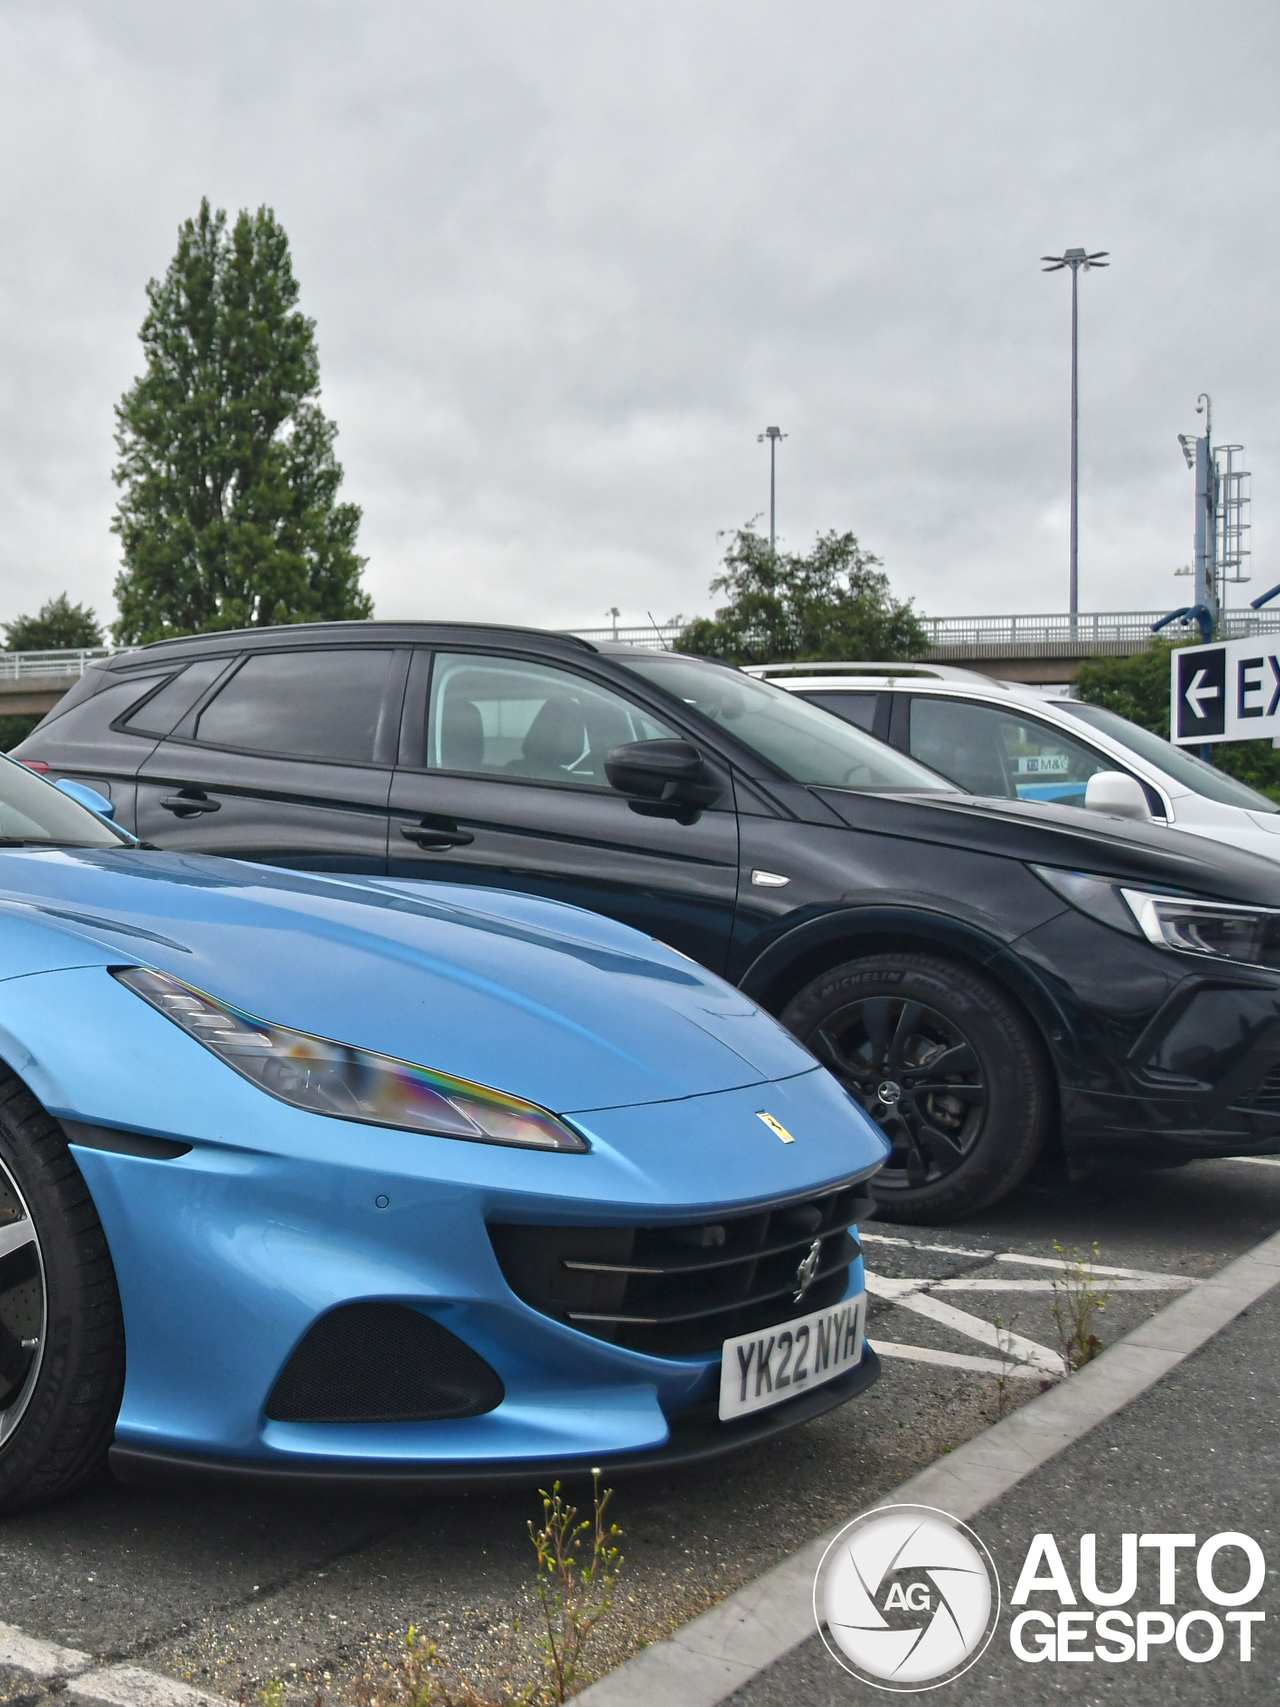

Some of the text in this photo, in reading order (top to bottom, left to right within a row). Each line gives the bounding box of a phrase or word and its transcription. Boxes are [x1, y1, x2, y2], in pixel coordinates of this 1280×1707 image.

[821, 971, 900, 999] MICHELIN
[736, 1303, 859, 1402] YK22 NYH
